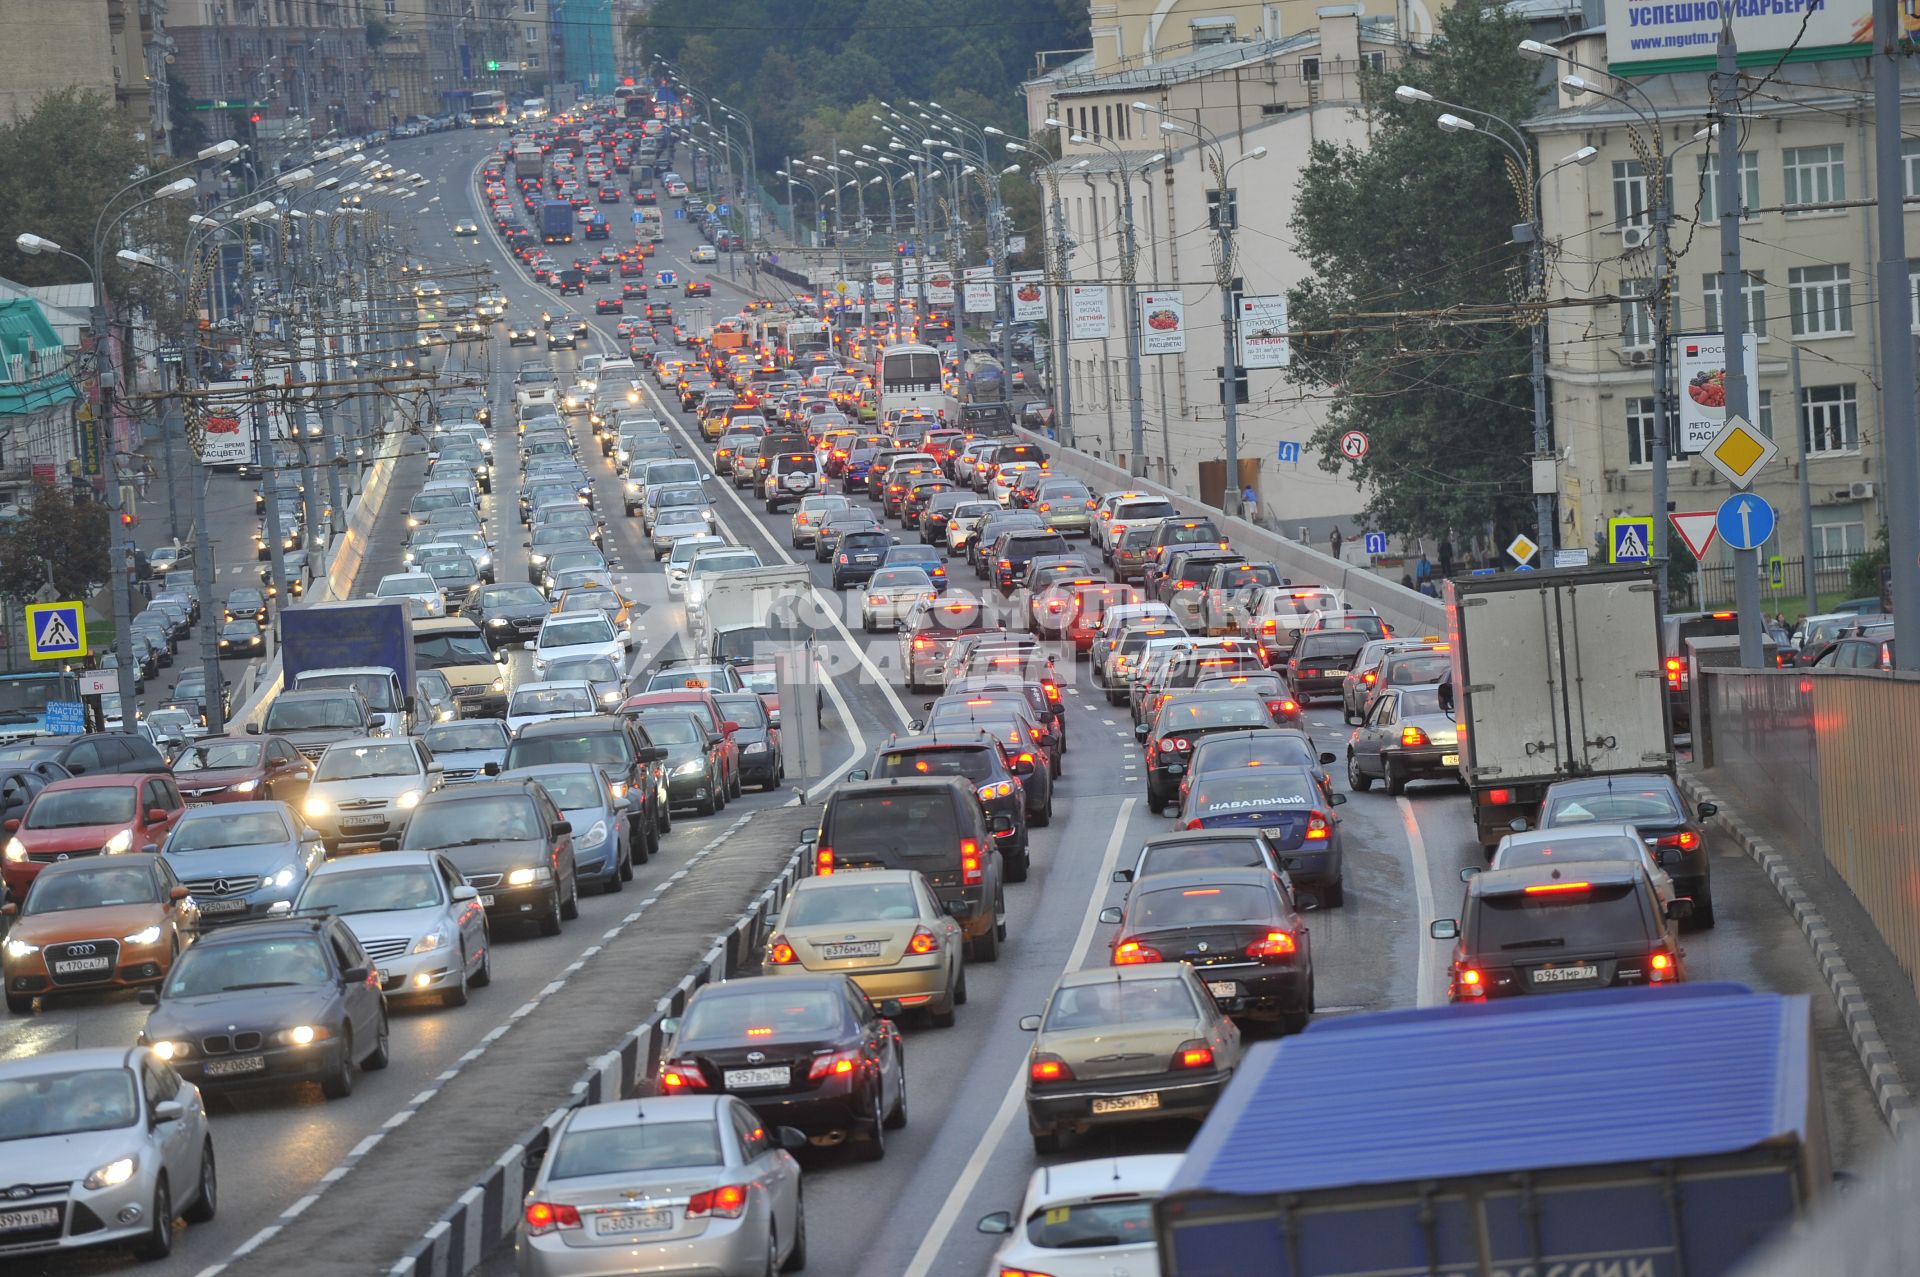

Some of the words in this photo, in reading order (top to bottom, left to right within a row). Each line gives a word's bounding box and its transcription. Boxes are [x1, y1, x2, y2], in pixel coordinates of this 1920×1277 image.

[1701, 345, 1749, 354] РОСБК
[1688, 421, 1711, 430] ЛЕТО
[47, 706, 83, 716] УЧАСТОК
[1208, 795, 1306, 811] НАВАЛЬНЫЙ
